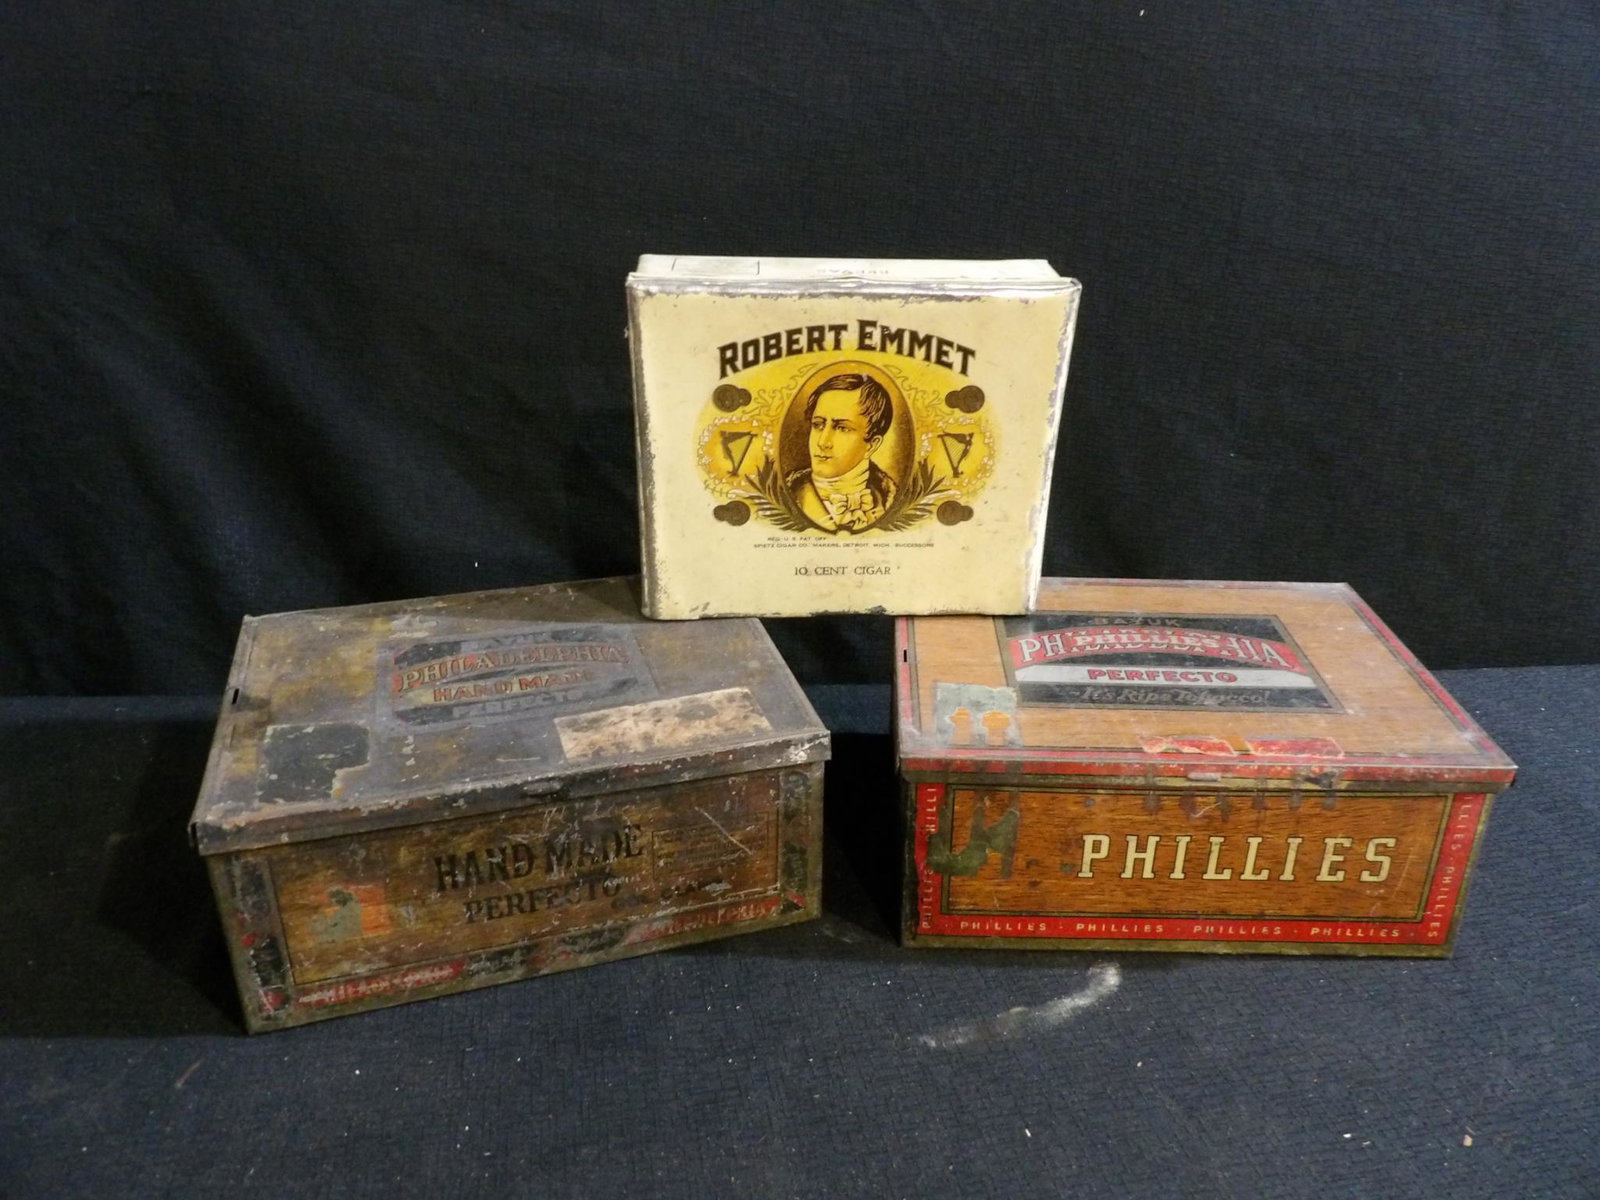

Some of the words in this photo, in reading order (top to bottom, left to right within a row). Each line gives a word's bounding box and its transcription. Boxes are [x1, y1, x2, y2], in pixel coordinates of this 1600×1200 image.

[716, 323, 849, 380] ROBERT
[856, 319, 976, 377] EMMET
[794, 566, 809, 576] 10
[814, 566, 848, 576] CENT
[854, 565, 892, 576] CIGAR
[1074, 633, 1220, 648] PHILLIES
[400, 643, 630, 692] PHILADELPHIA
[1086, 668, 1239, 684] PERFECTO
[1117, 687, 1169, 705] Ripe
[434, 842, 536, 892] HAND
[543, 823, 644, 874] MADE
[1076, 833, 1398, 882] PHILLIES
[463, 872, 622, 924] PERFECTO
[1427, 866, 1455, 938] PHILLIES
[960, 921, 1047, 931] PHILLIES
[1076, 923, 1164, 933] PHILLIES
[1193, 925, 1282, 935] PHILLIES
[1311, 927, 1400, 937] PHILLIES
